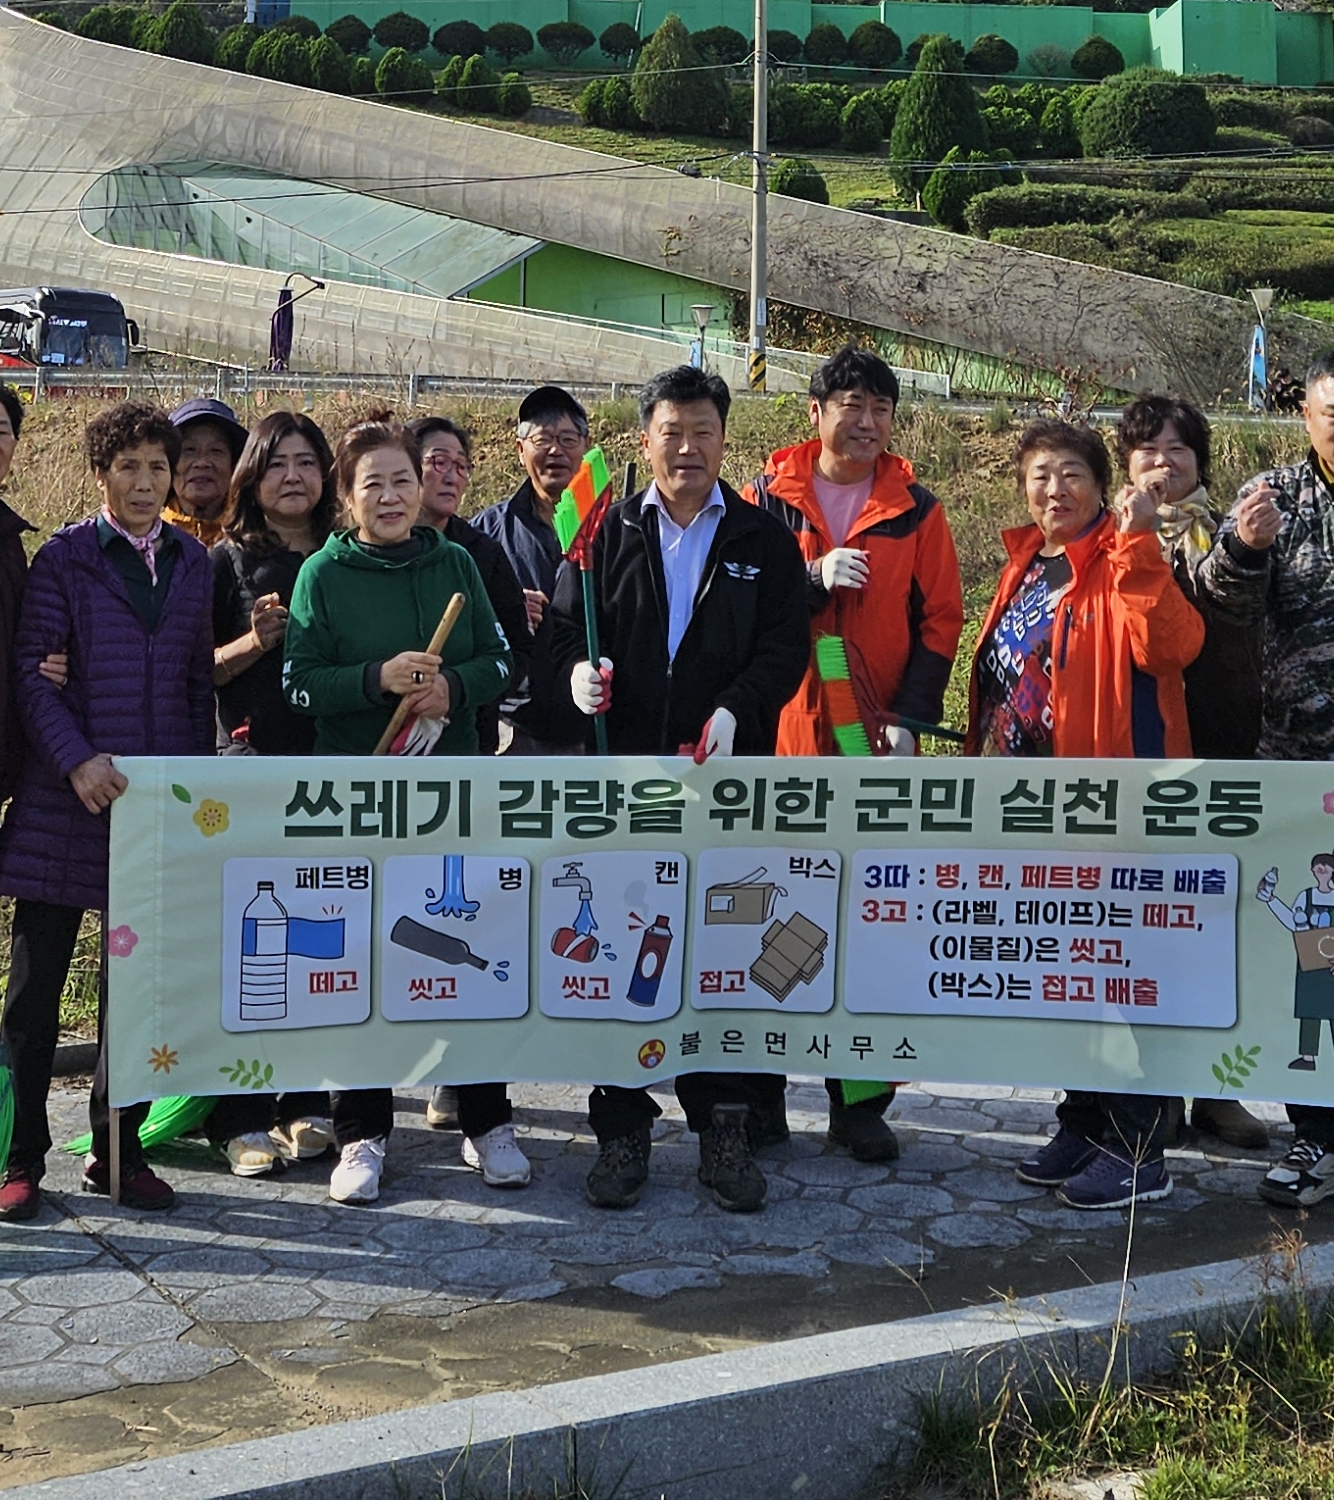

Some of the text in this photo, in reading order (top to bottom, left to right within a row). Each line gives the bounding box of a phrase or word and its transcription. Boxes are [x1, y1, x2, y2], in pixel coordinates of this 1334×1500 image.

[284, 777, 1263, 839] 쓰레기 감량을 위한 군민 실천 운동
[295, 865, 369, 890] 페트병
[499, 867, 522, 890] 병
[655, 861, 679, 884] 캔
[789, 856, 836, 879] 박스
[864, 864, 910, 889] 3따
[936, 864, 968, 890] 병,
[978, 864, 1011, 890] 캔,
[1021, 865, 1101, 890] 페트병
[1110, 867, 1163, 891] 따로
[1174, 868, 1227, 894] 배출
[861, 899, 907, 923] 3고
[932, 899, 1004, 926] (라벨,
[1015, 900, 1134, 927] 테이프)는
[1142, 903, 1203, 932] 떼고,
[929, 934, 1131, 968] (이물질)은 씻고,
[309, 971, 359, 994] 떼고
[408, 978, 458, 1001] 씻고
[561, 976, 611, 1000] 씻고
[699, 970, 746, 993] 접고
[928, 971, 1158, 1007] (박스)는 접고 배출
